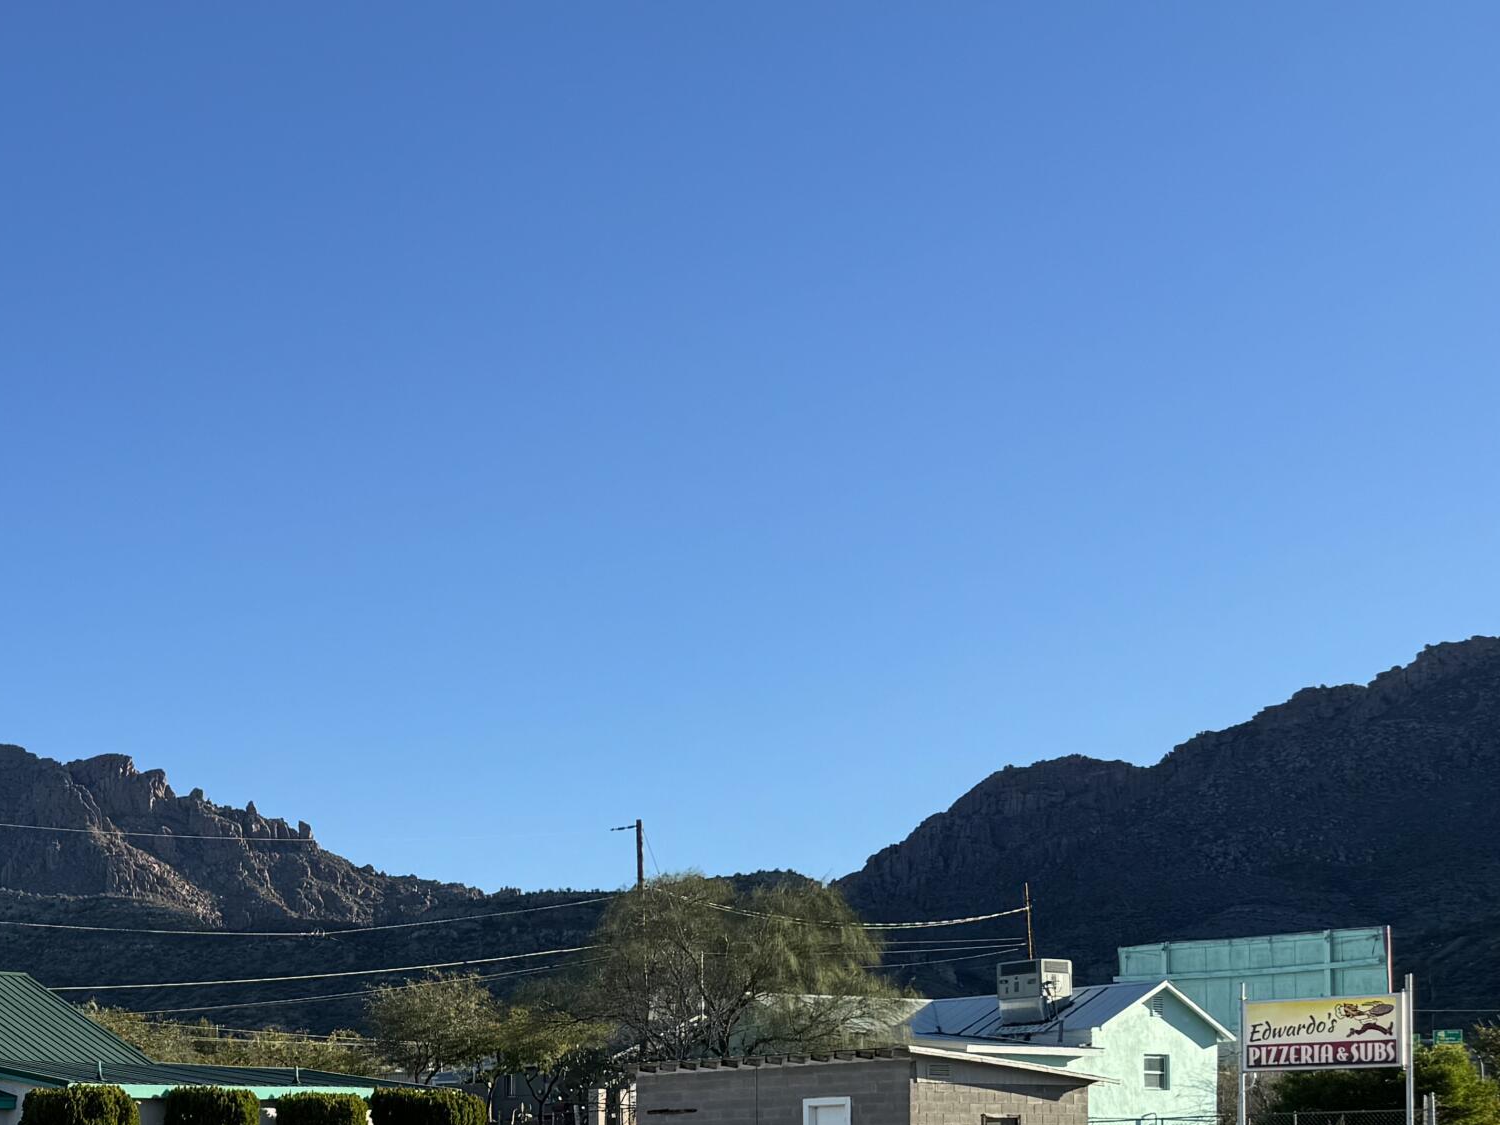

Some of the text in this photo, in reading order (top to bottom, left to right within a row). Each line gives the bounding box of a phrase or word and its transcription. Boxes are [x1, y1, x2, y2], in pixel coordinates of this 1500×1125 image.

[1249, 1012, 1338, 1042] Edwardo's
[1248, 1041, 1396, 1066] PIZZERIA & SUBS
